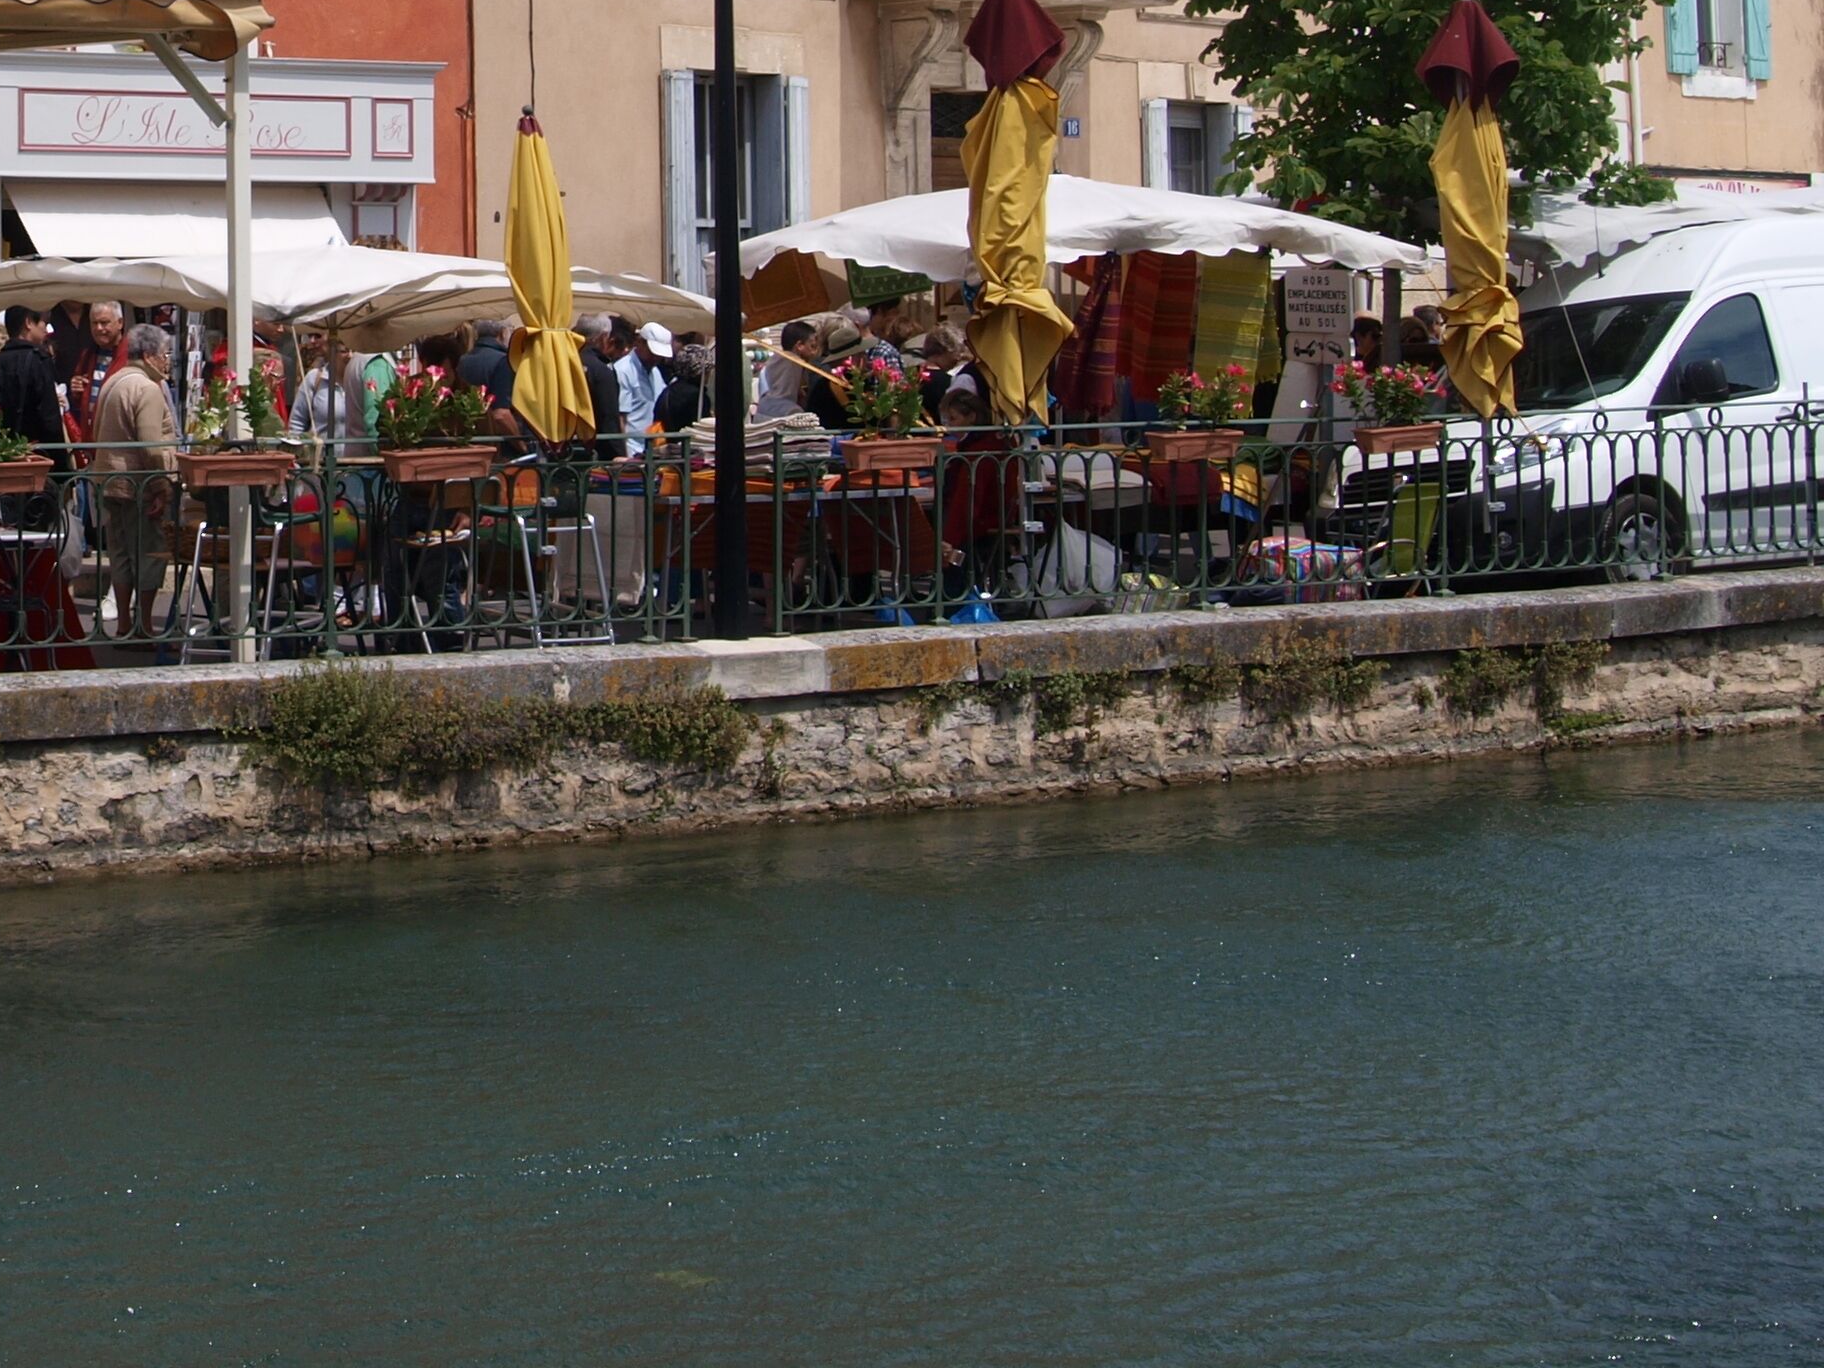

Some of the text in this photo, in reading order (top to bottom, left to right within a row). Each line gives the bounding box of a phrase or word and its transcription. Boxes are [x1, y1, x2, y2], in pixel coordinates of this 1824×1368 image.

[1302, 275, 1330, 286] HORS
[1287, 289, 1346, 300] EMPLACEMENTS
[1288, 301, 1346, 314] MATÉRIALISÉS
[1298, 317, 1336, 328] AU SOL
